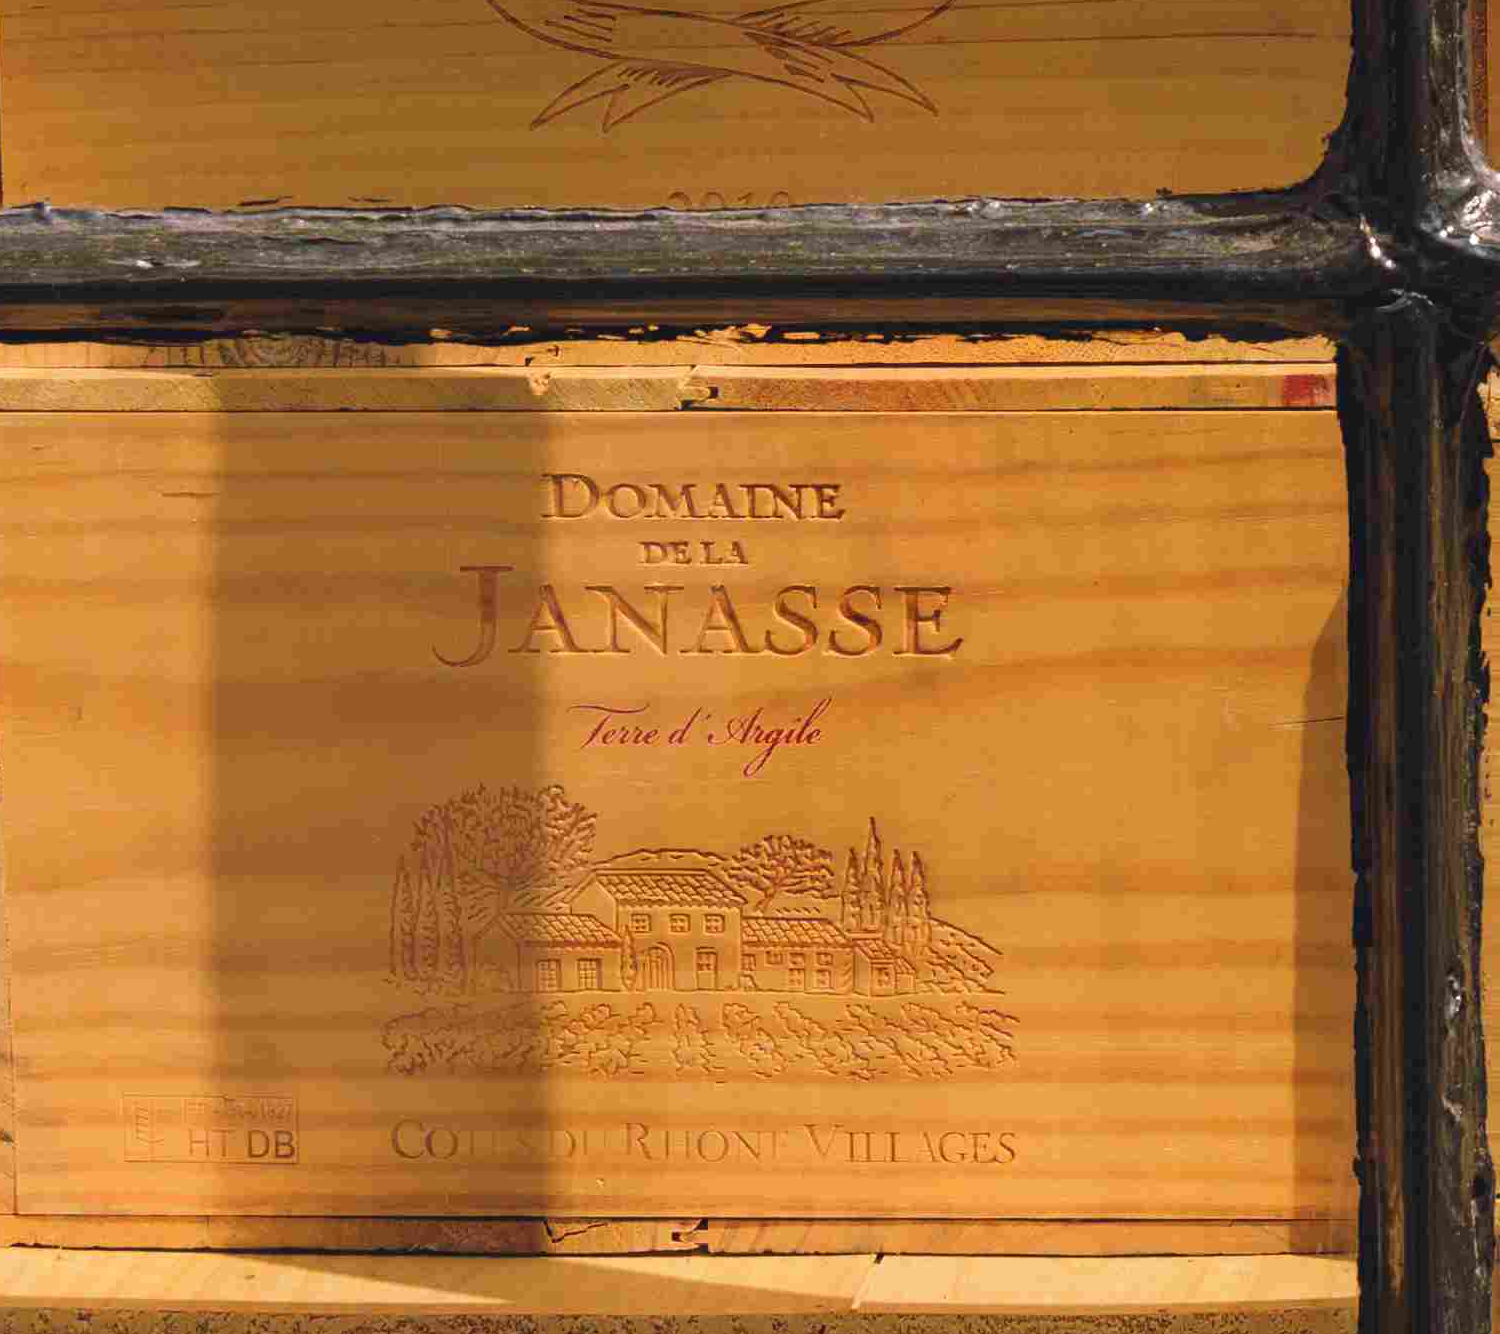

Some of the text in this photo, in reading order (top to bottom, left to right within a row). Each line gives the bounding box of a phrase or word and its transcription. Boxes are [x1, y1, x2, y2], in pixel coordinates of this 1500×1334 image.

[541, 472, 846, 523] DOMAINE
[639, 539, 749, 568] DE LA
[432, 563, 966, 670] JANASSE
[565, 699, 662, 750] Terre
[707, 691, 836, 779] Argile
[246, 1129, 297, 1159] DB
[804, 1122, 1020, 1166] VILLAGES
